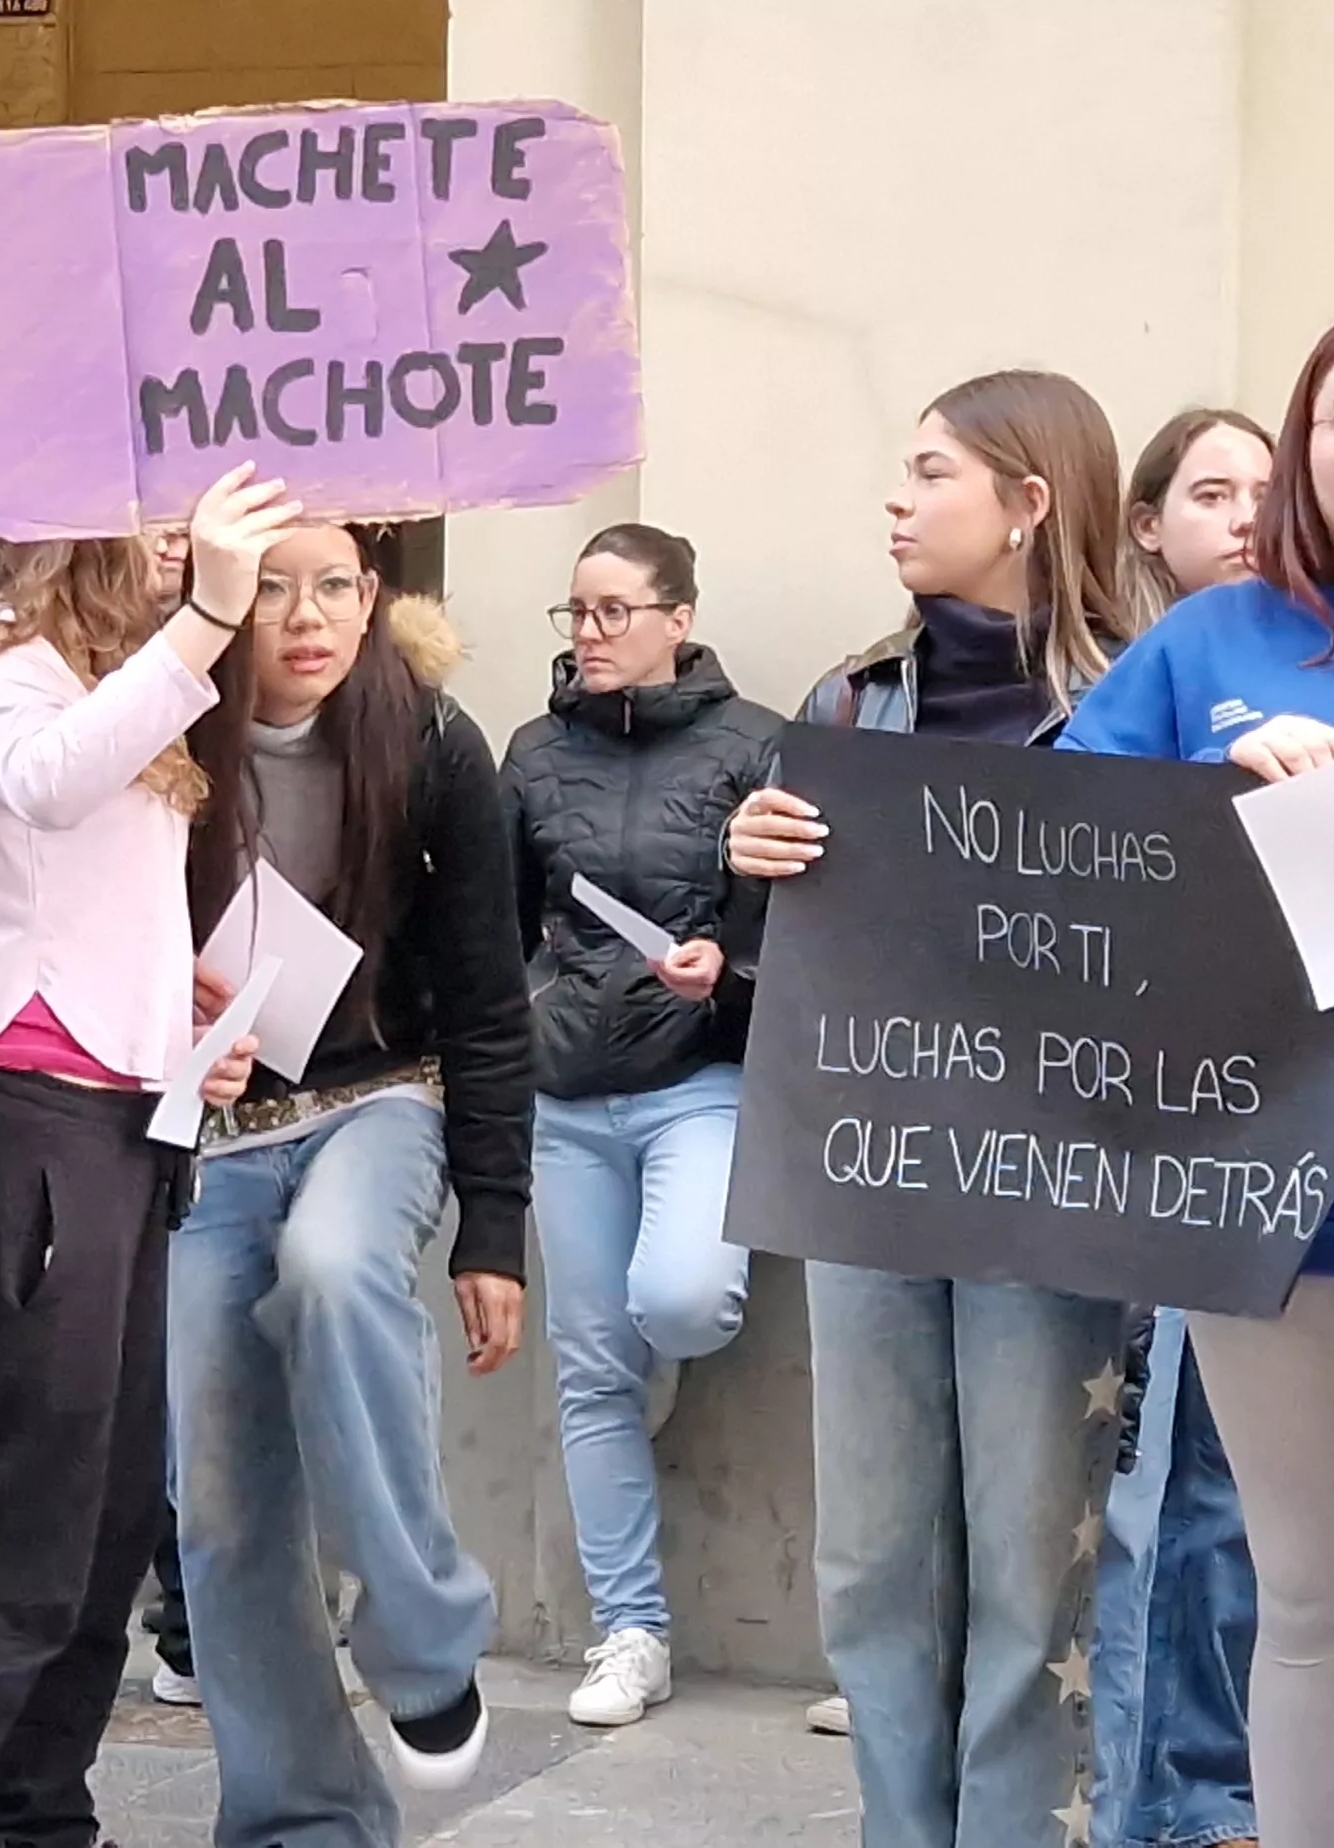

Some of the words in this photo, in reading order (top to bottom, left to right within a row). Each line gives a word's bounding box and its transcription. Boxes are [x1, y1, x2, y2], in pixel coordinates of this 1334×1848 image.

[125, 117, 547, 214] MACHETE
[190, 237, 321, 335] AL
[138, 337, 565, 454] MACHOTE
[922, 785, 1001, 865] NO
[1016, 810, 1177, 882] LUCHAS
[977, 904, 1061, 975] POR
[816, 1014, 1007, 1083] LUCHAS
[1037, 1031, 1133, 1106] POR
[1156, 1050, 1261, 1115] LAS
[823, 1118, 932, 1190] QUE
[948, 1127, 1130, 1213] VIENEN
[1150, 1150, 1329, 1241] DETRÁS
